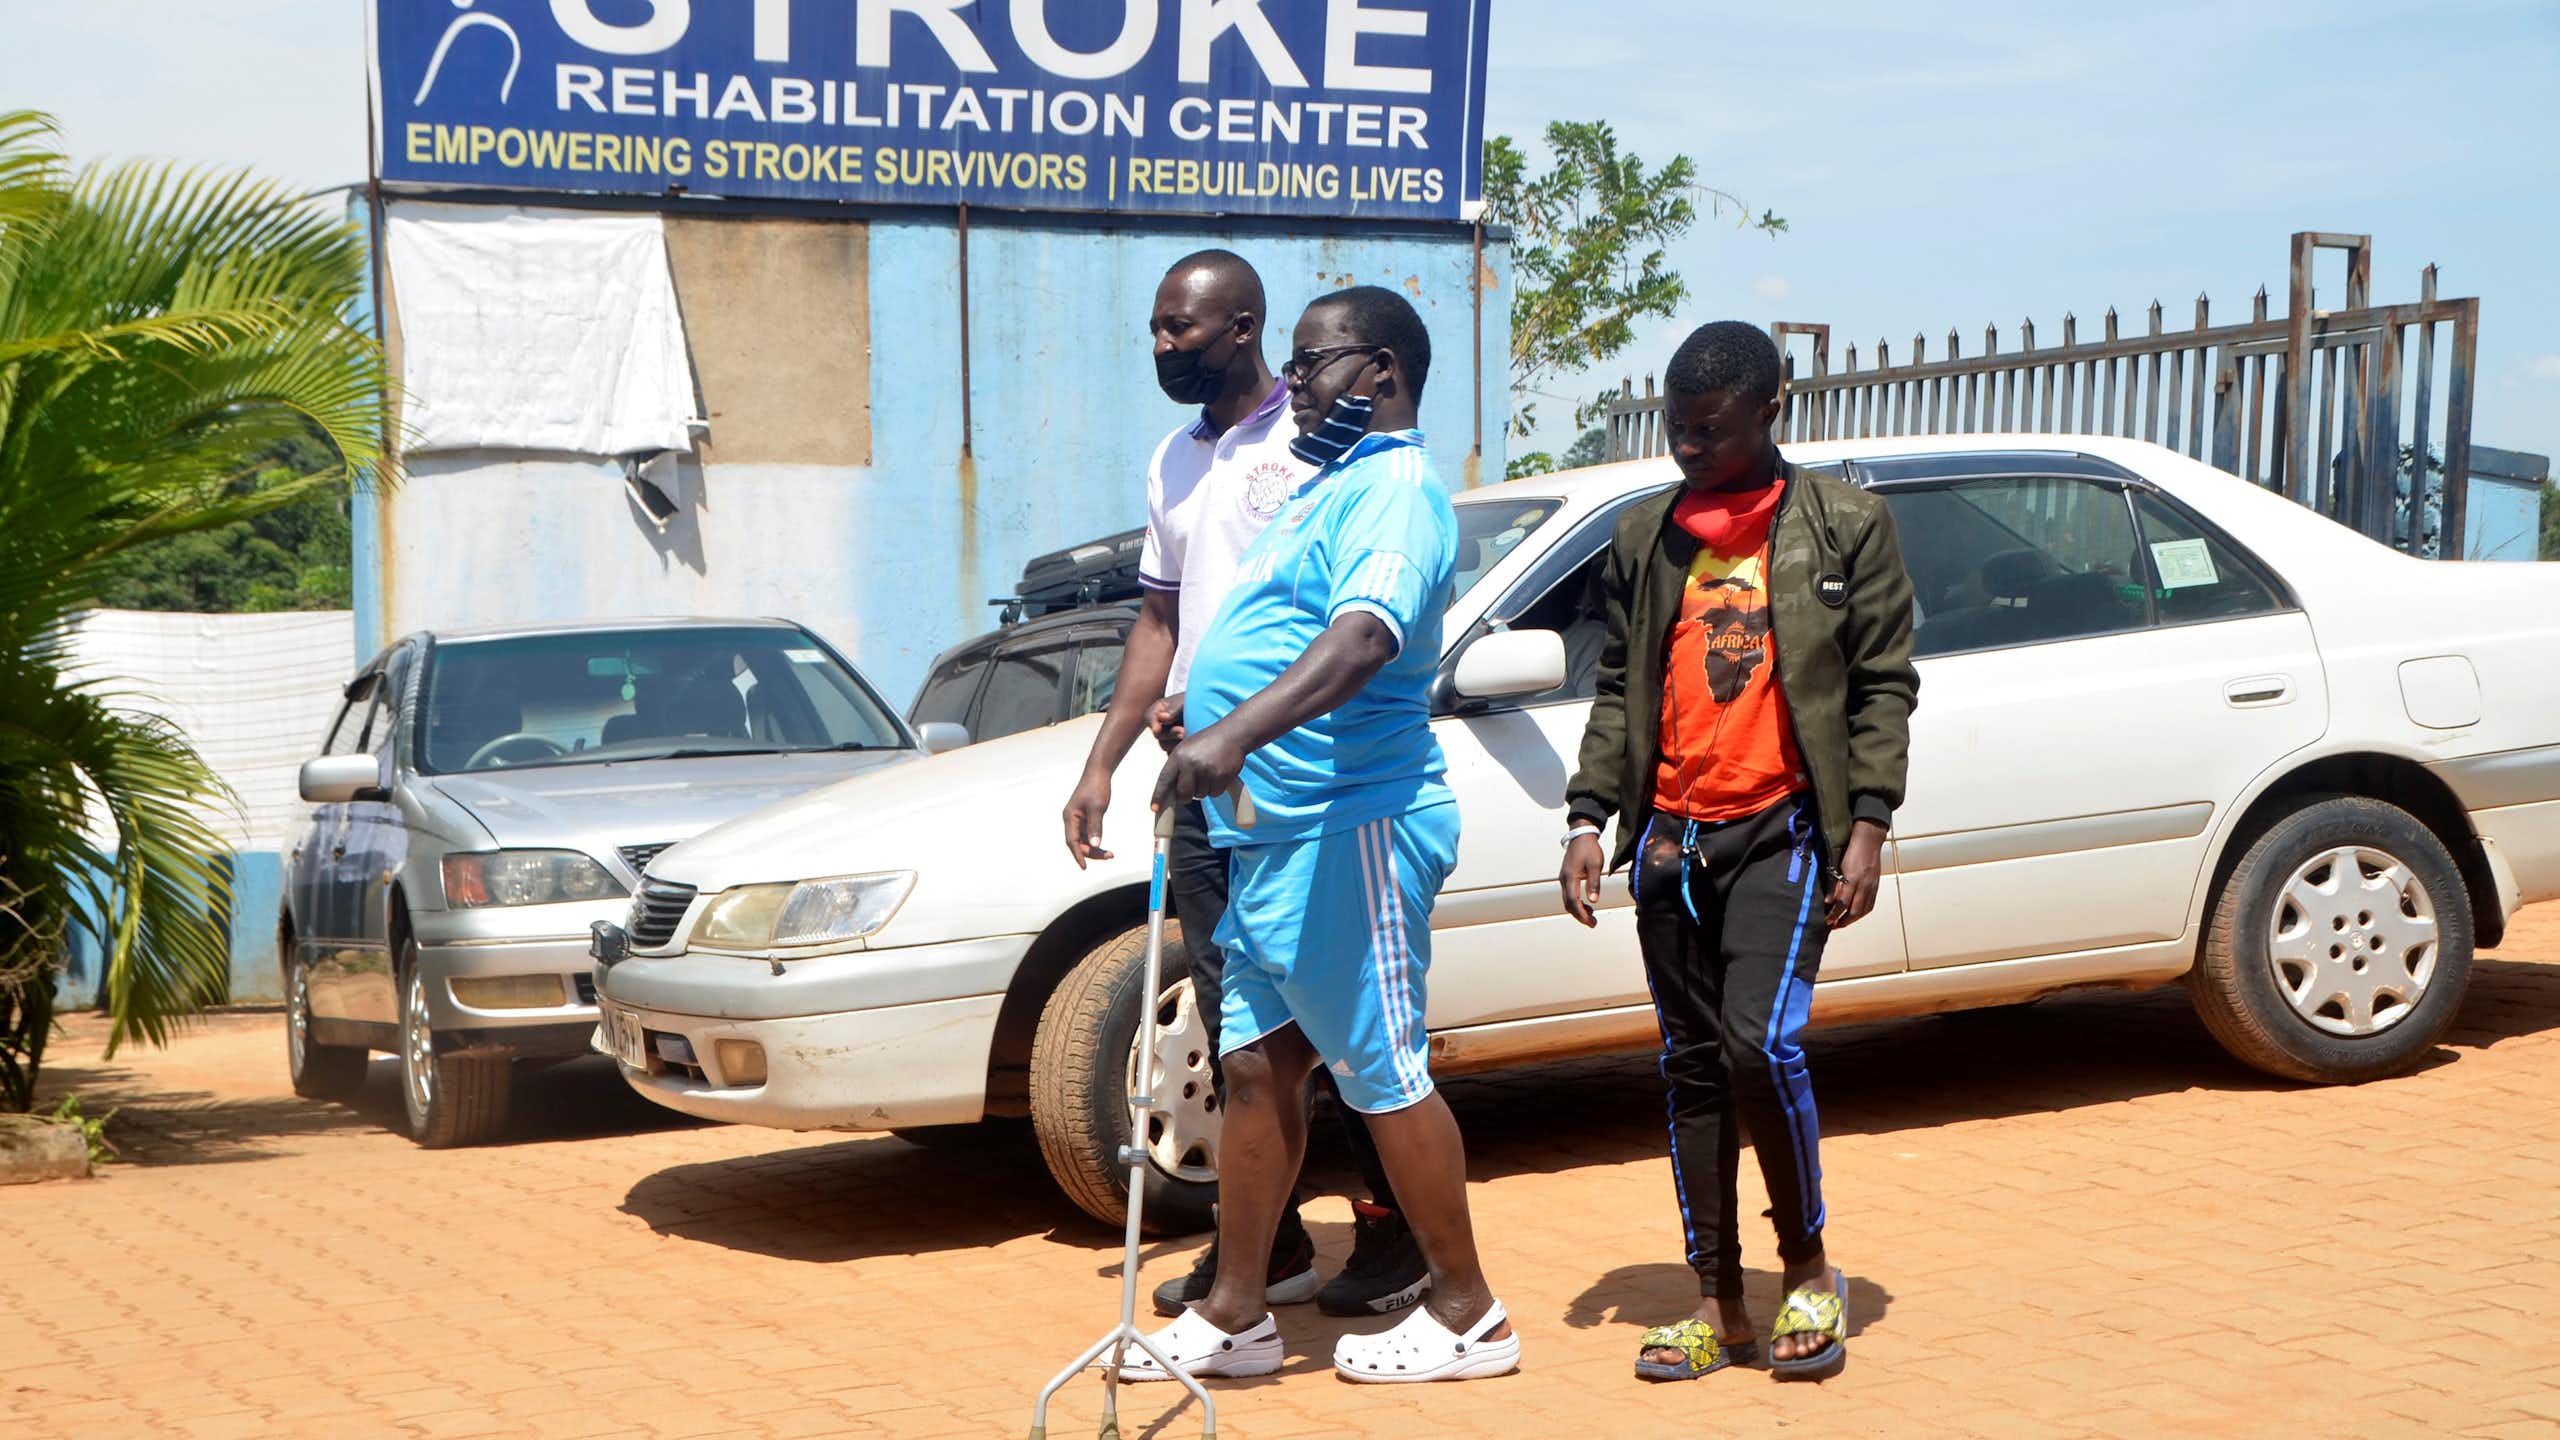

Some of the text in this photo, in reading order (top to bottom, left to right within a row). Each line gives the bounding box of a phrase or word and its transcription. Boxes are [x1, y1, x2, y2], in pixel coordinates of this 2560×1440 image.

[556, 63, 1429, 150] REHABILITATION CENTER
[406, 122, 692, 176] EMPOWERING
[703, 139, 863, 184] STROKE
[874, 146, 1087, 191] SURVIVORS
[1128, 157, 1340, 200] REBUILDING
[1350, 165, 1444, 206] LIVES
[1246, 462, 1295, 481] STROKE
[1822, 581, 1844, 591] BEST
[1711, 634, 1761, 650] AFRICA
[1385, 1292, 1415, 1311] FILA
